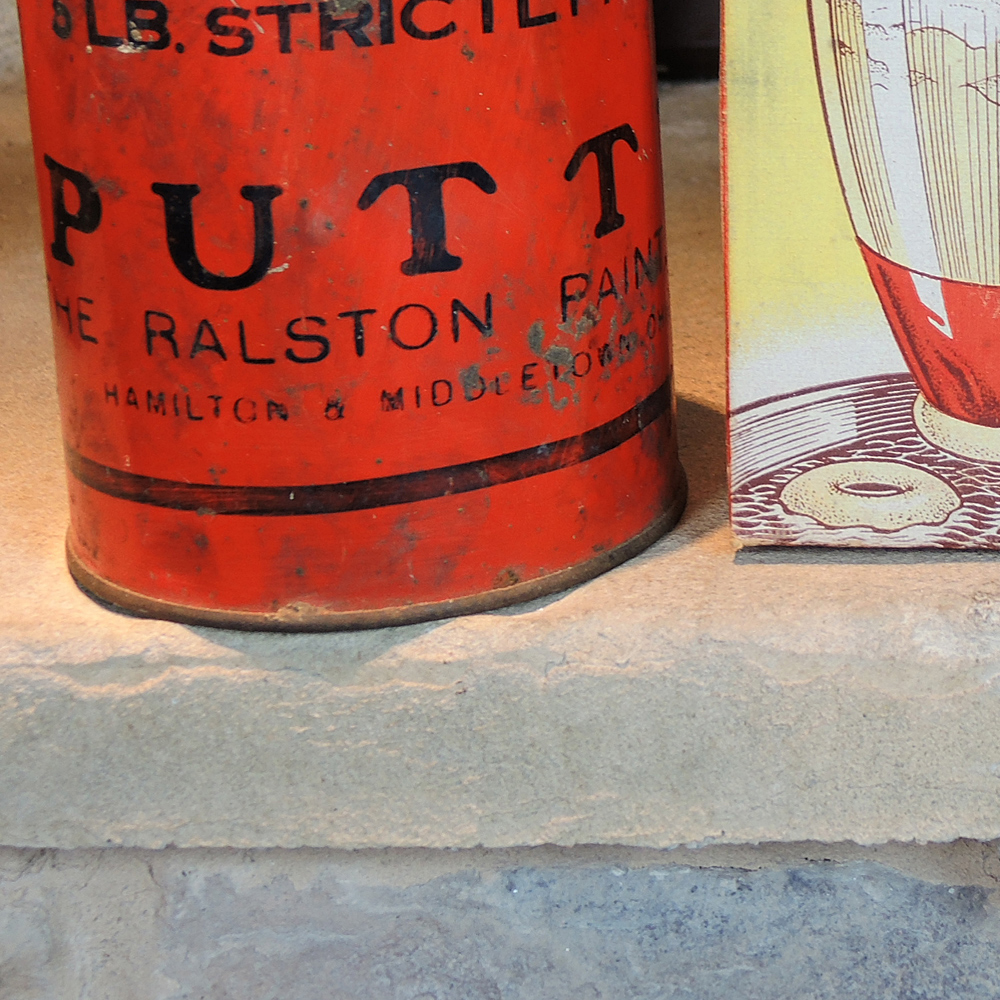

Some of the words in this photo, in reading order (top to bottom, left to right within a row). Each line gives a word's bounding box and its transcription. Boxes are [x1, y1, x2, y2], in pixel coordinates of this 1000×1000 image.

[43, 123, 640, 291] PUTT
[50, 285, 99, 345] HE
[143, 292, 494, 366] RALSTON
[104, 383, 289, 424] HAMILTON
